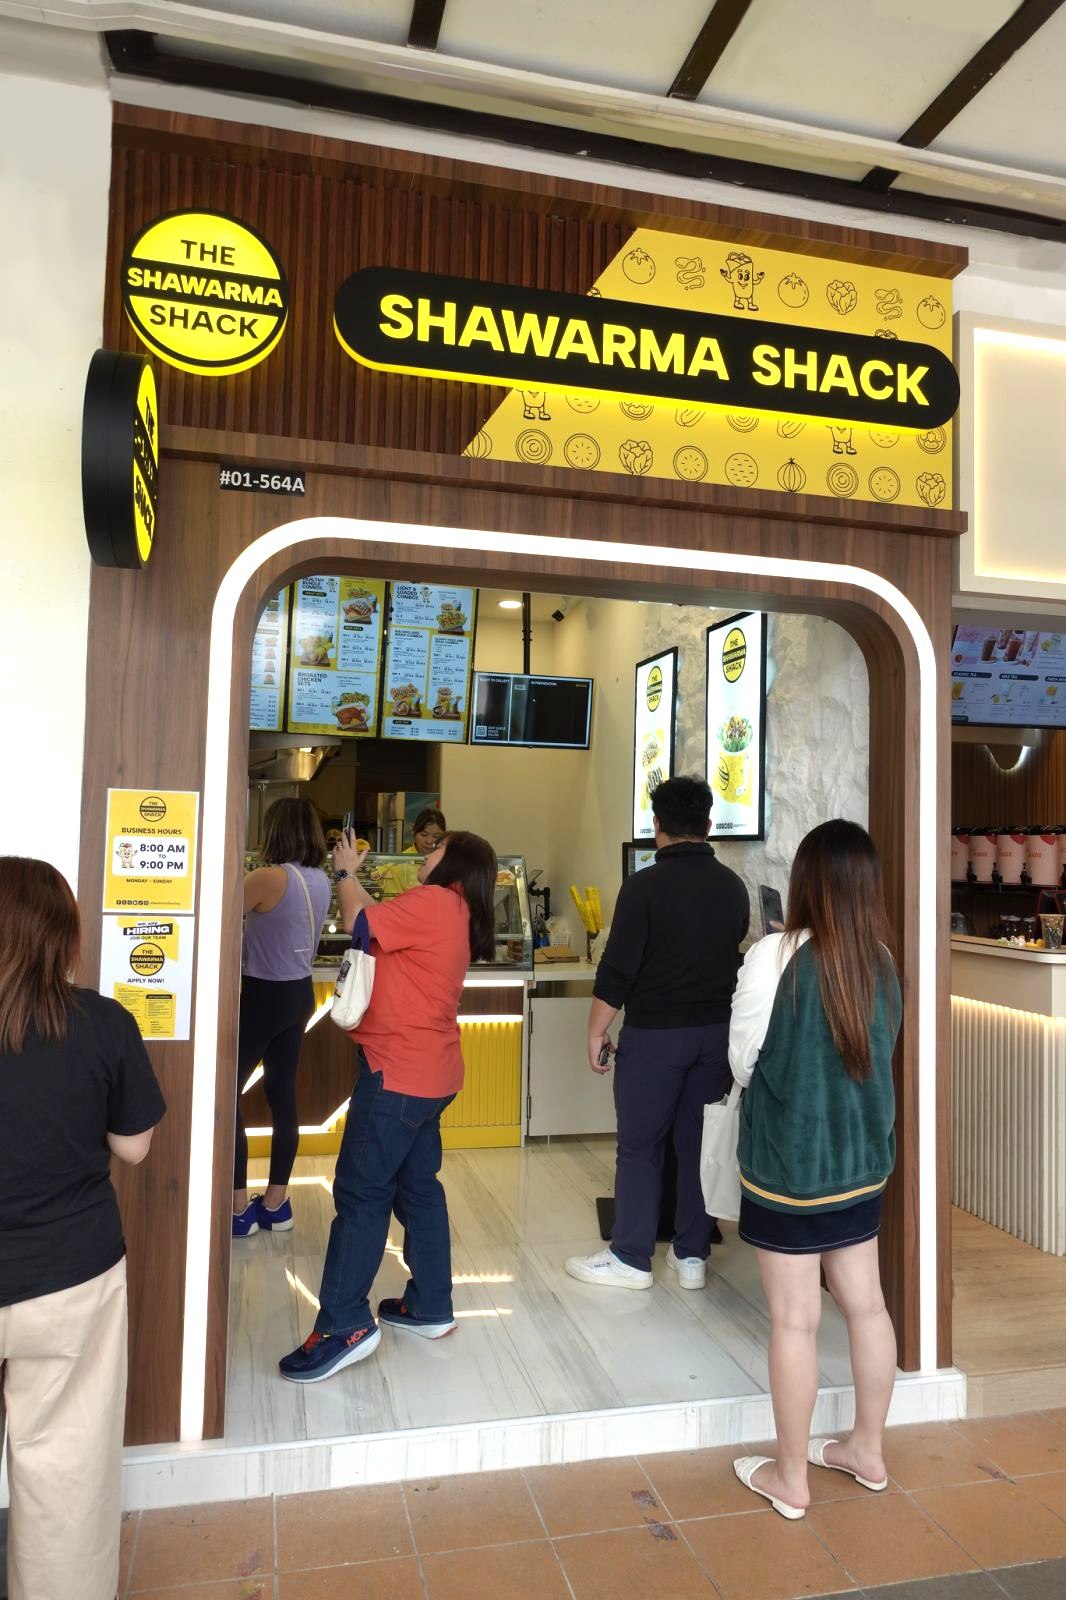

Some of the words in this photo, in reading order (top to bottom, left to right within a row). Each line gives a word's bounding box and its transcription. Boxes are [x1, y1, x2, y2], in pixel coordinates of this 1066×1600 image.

[180, 239, 236, 267] THE
[127, 267, 284, 308] SHAWARMA
[149, 303, 259, 340] SHACK
[379, 294, 730, 381] SHAWARMA
[751, 344, 930, 406] SHACK
[219, 469, 305, 493] #01-564A
[139, 844, 164, 852] 8:00
[167, 844, 185, 853] AM
[139, 861, 164, 869] 9:00
[167, 861, 184, 870] PM
[126, 925, 170, 935] HIRING
